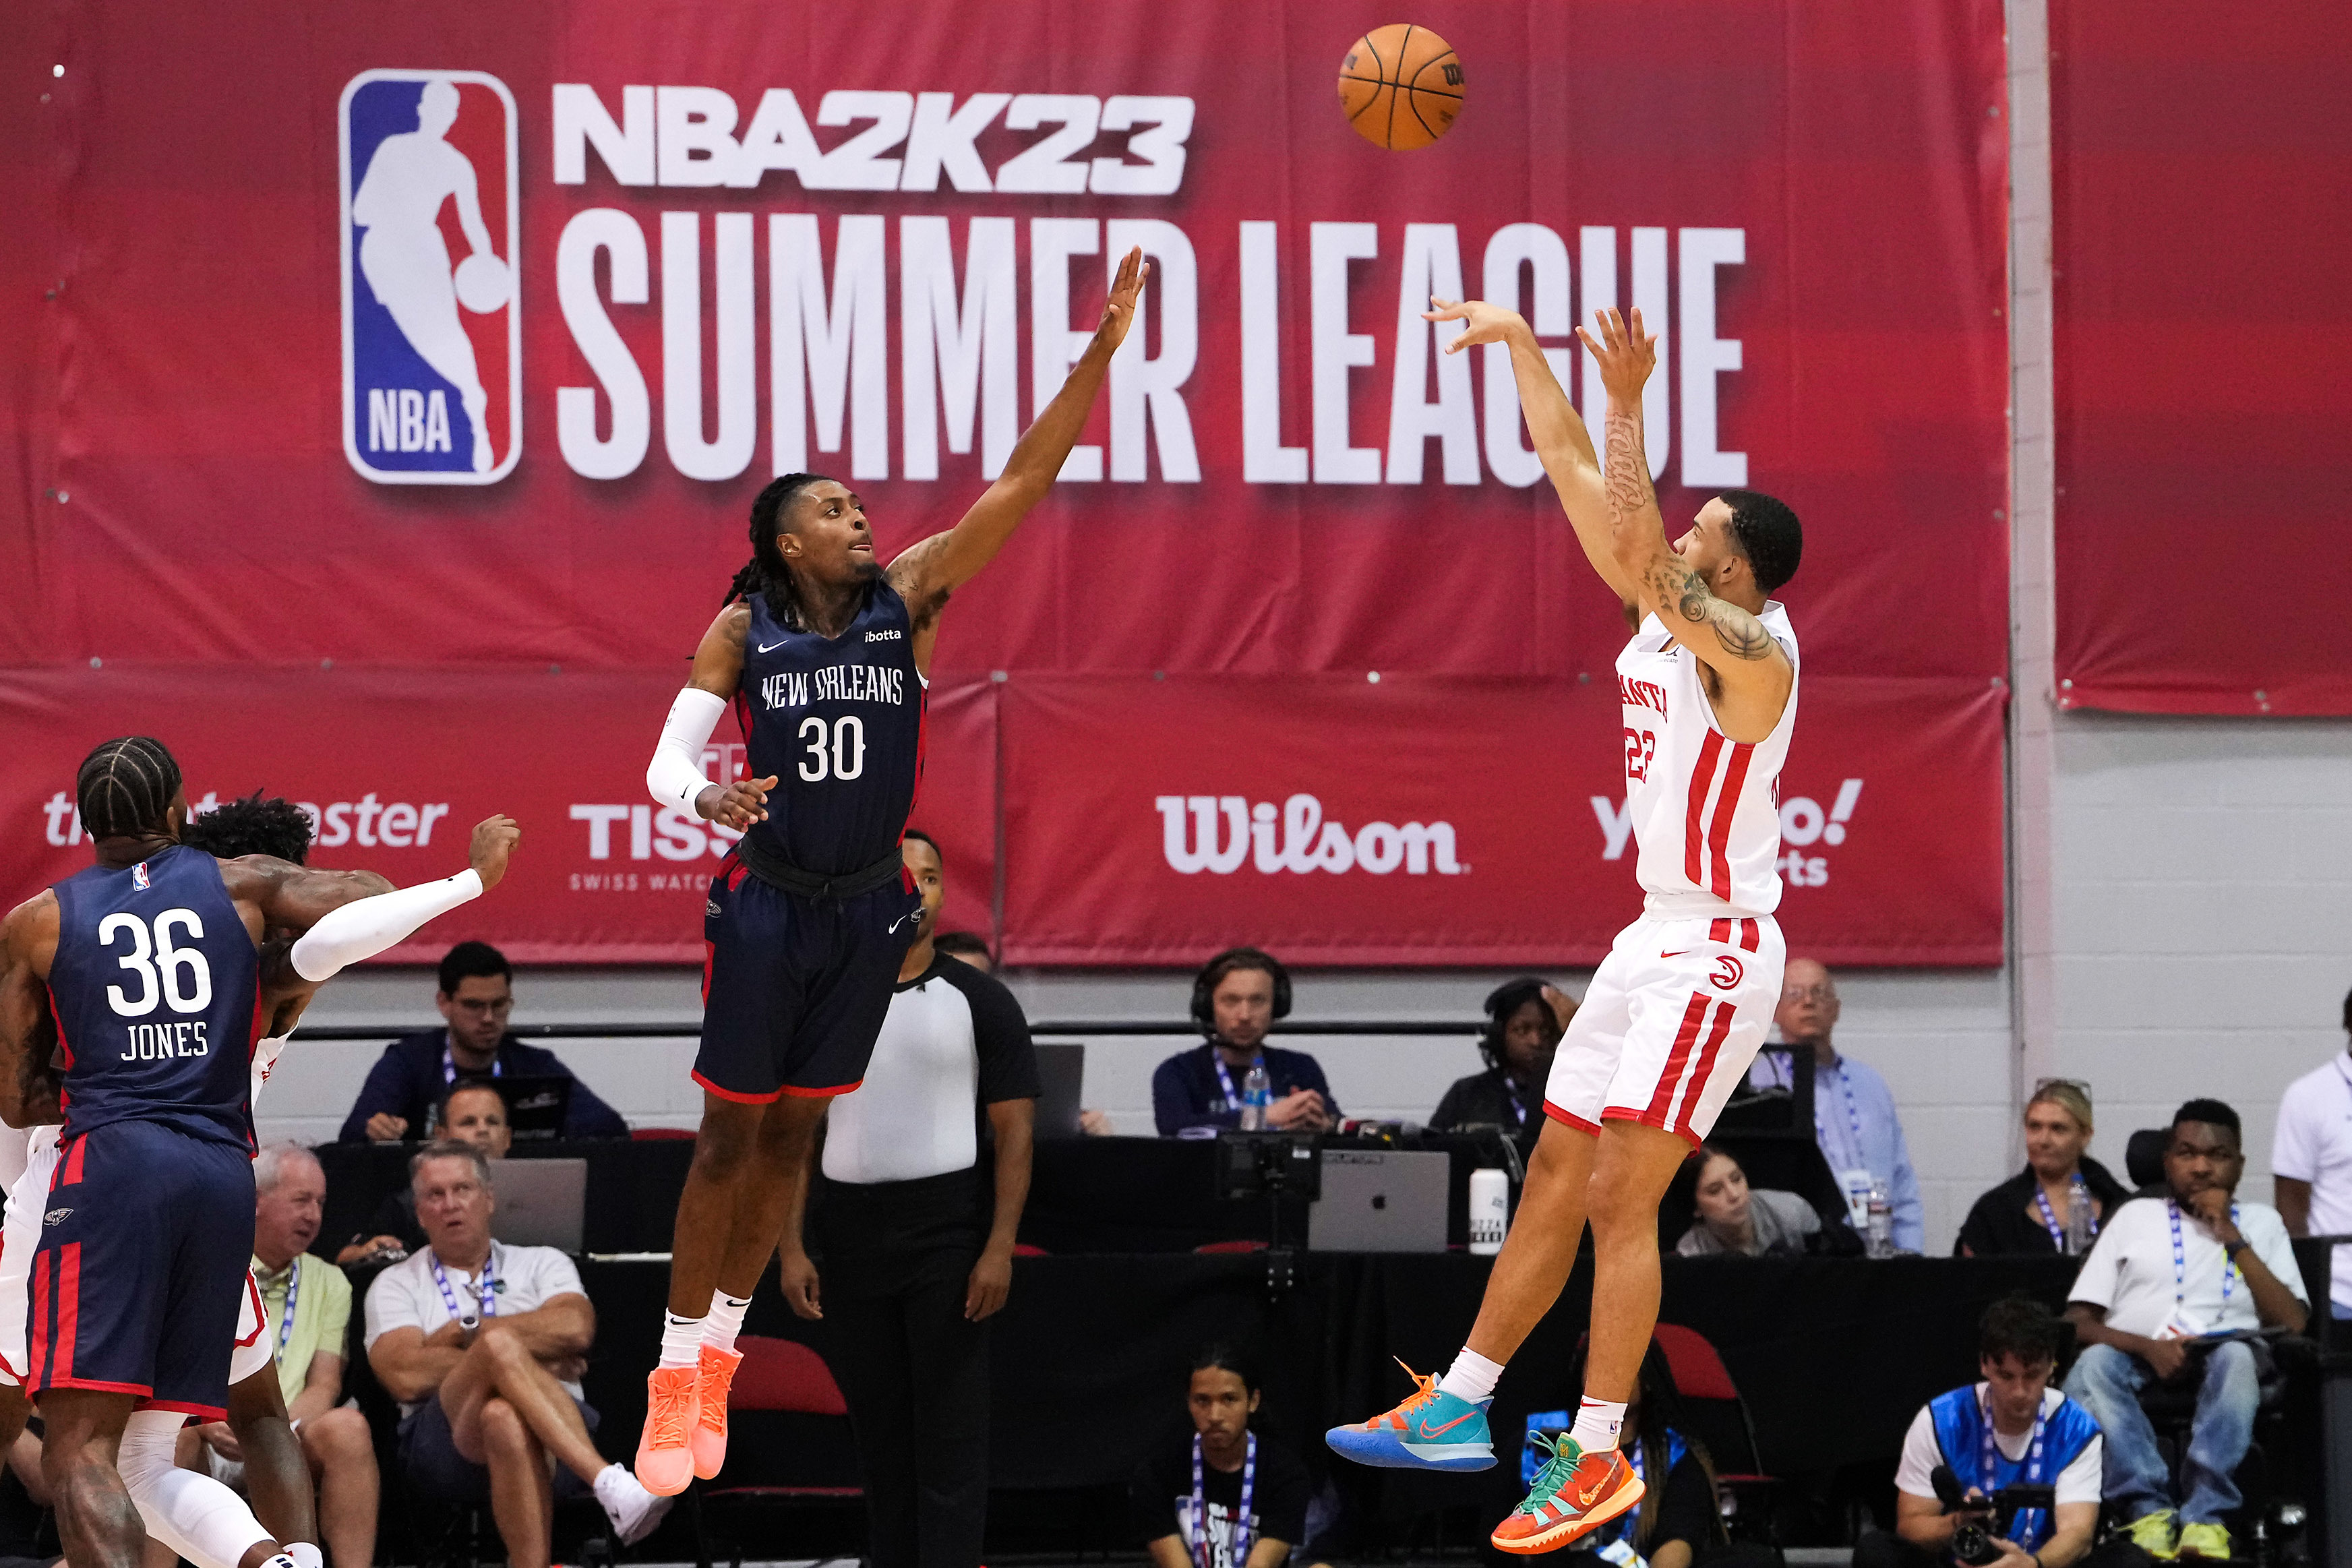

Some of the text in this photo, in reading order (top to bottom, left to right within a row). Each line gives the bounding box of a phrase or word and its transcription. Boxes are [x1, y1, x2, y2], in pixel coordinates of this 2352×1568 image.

[553, 83, 1195, 195] NBA2K23
[556, 207, 1202, 481] SUMMER
[1239, 221, 1749, 489] LEAGUE
[368, 388, 452, 453] NBA
[865, 629, 901, 642] ibotta
[762, 665, 903, 710] NEW ORLEANS
[798, 715, 866, 782] 30
[1155, 793, 1460, 874] Wilson
[570, 873, 709, 891] SWISS WATC
[98, 908, 212, 1017] 36
[121, 1021, 209, 1061] JONES
